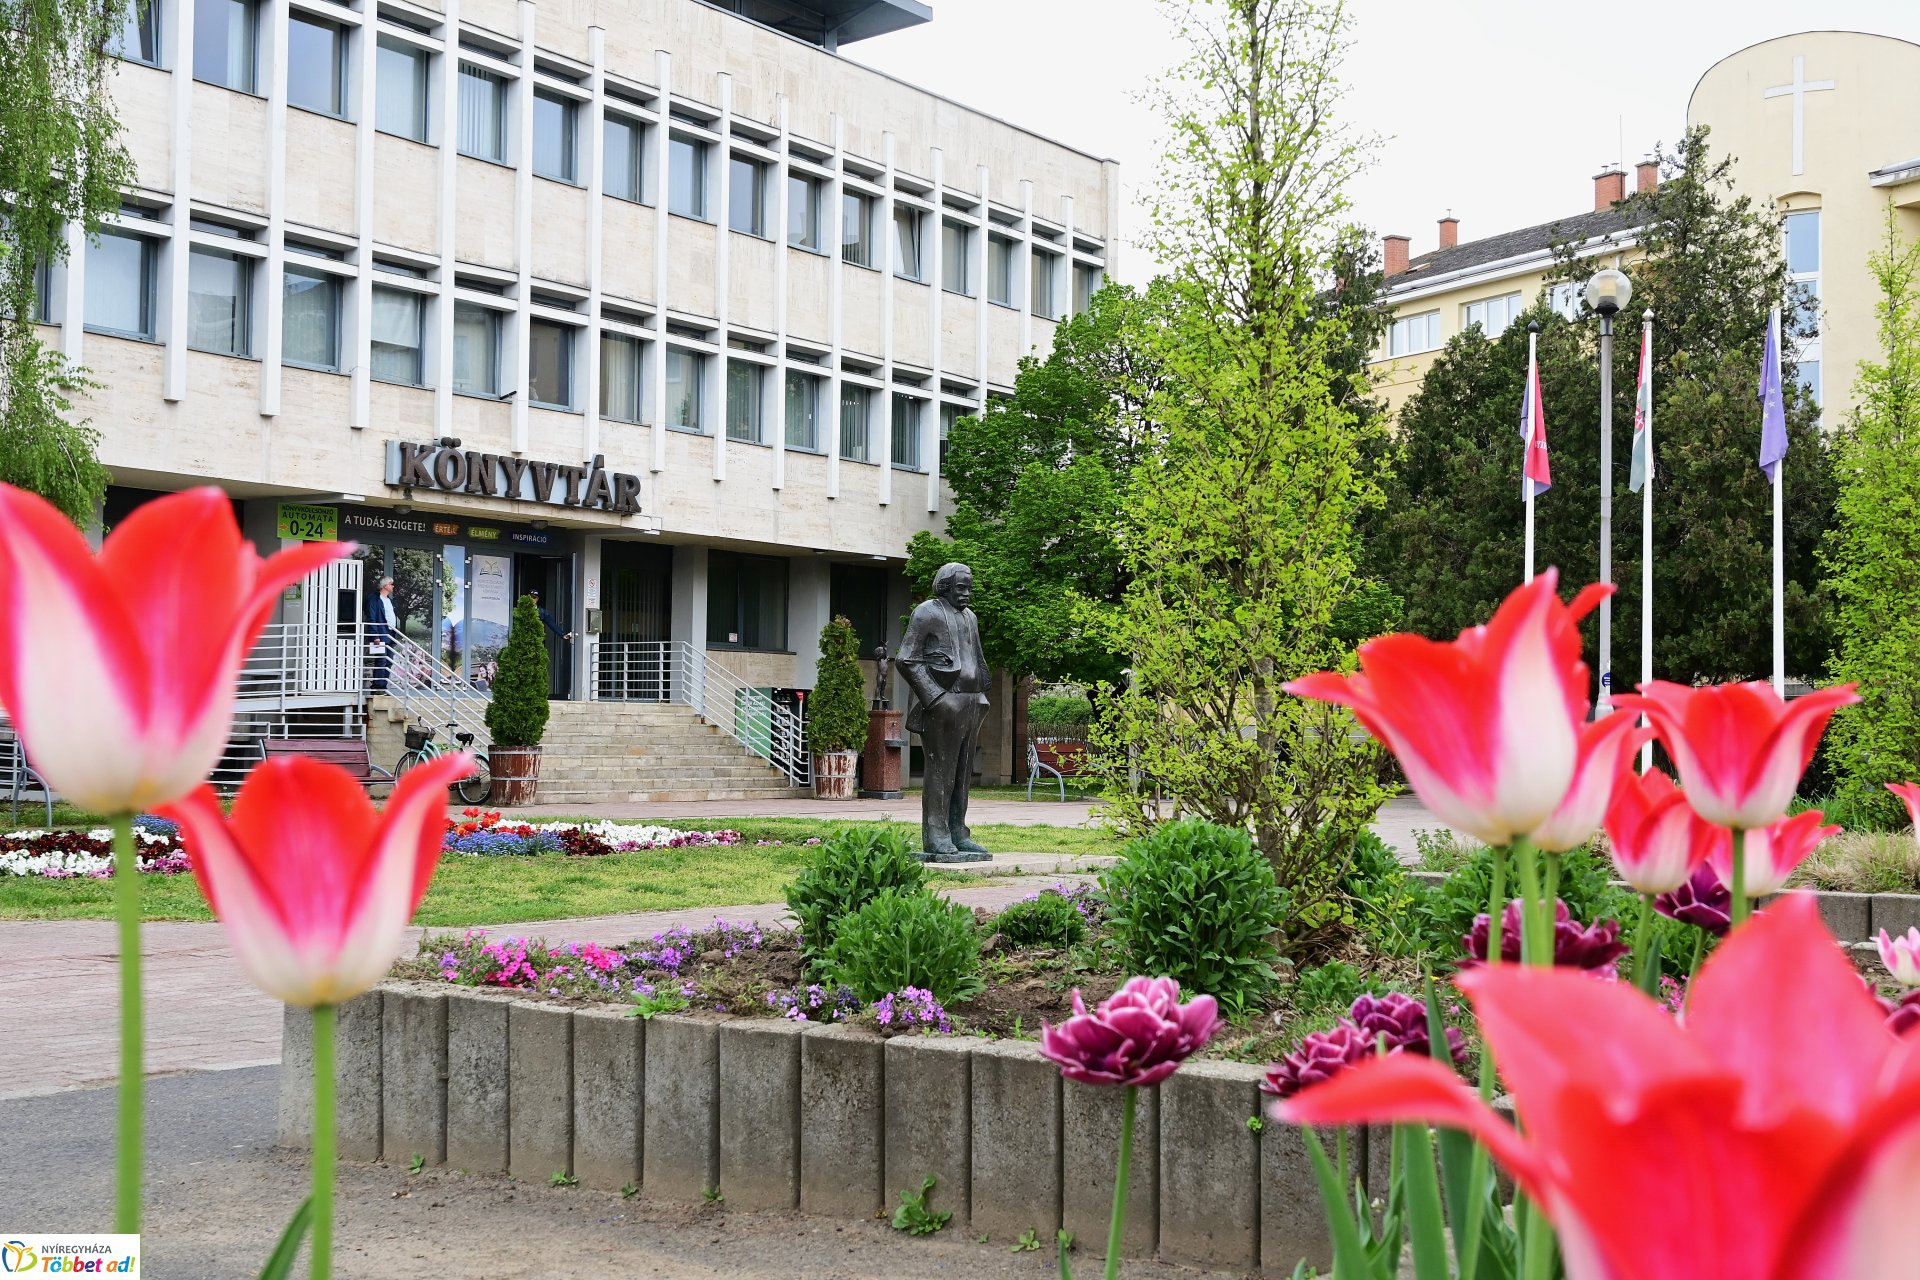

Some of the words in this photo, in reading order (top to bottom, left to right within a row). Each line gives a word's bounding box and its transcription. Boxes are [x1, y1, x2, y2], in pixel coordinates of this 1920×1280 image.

[400, 437, 642, 515] KÖNYVTÁR
[282, 511, 334, 522] AUTOMATA
[344, 515, 352, 525] A
[353, 515, 385, 528] TUDÁS
[386, 519, 426, 532] SZIGETE!
[290, 520, 324, 538] 0-24
[470, 527, 497, 539] ÉLMÉNY
